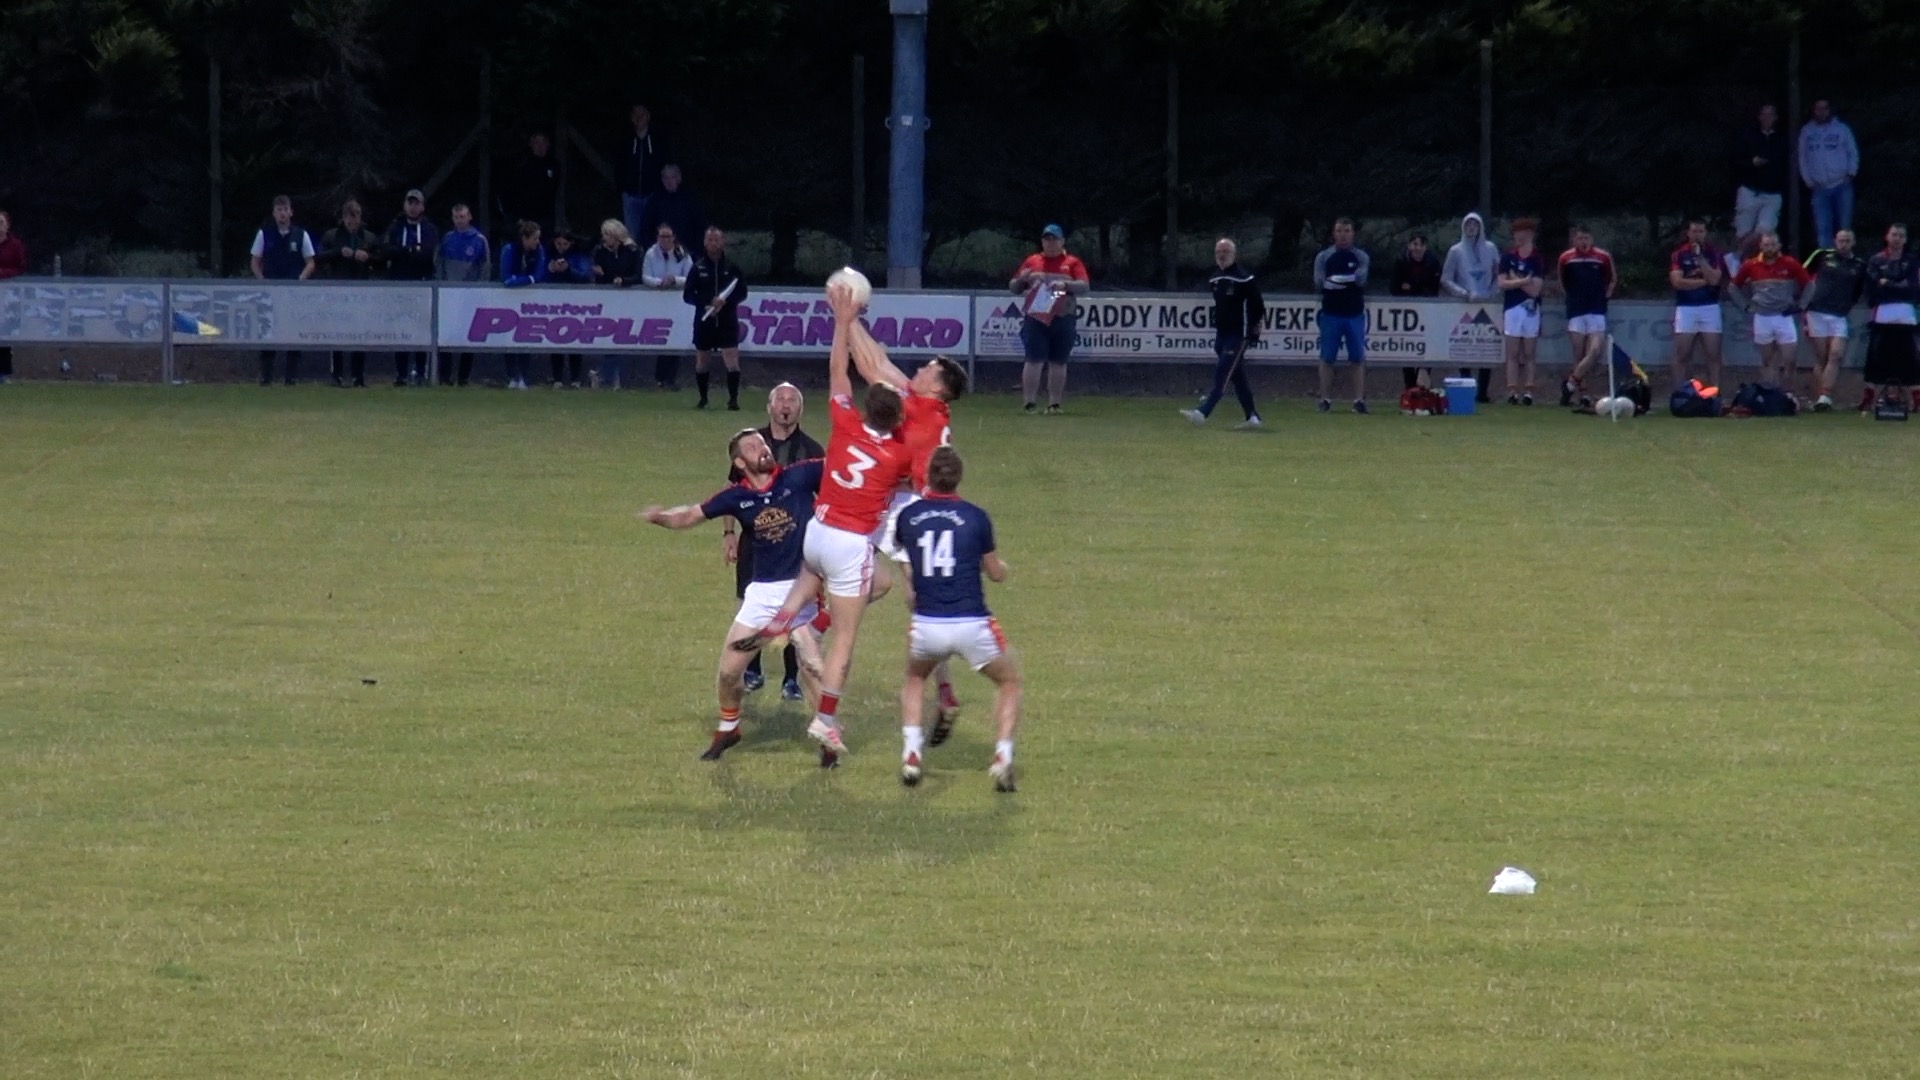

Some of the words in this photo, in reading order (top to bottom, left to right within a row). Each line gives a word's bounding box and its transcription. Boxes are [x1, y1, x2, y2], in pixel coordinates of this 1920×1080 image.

[520, 303, 602, 315] Wexford
[759, 299, 809, 314] New
[1158, 305, 1216, 328] McGE
[1377, 308, 1425, 332] LTD.
[467, 308, 672, 345] PEOPLE
[830, 445, 878, 489] 3
[916, 529, 957, 578] 14
